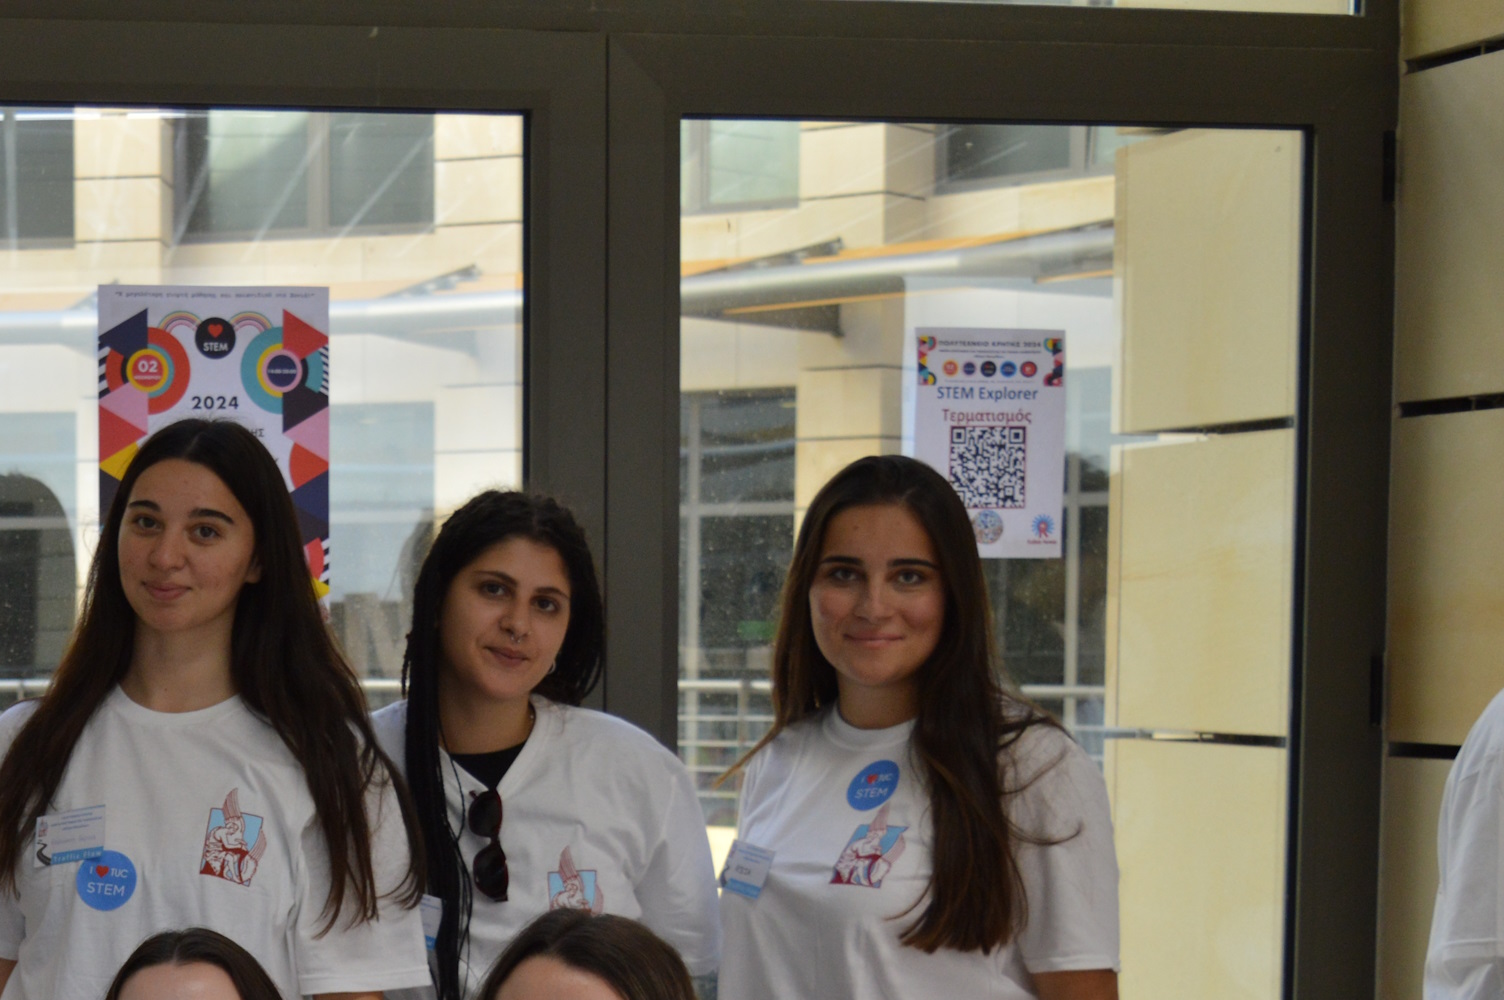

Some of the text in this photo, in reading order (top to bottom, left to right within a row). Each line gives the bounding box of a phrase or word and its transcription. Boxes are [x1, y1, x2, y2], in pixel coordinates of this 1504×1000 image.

[203, 342, 228, 352] STEM
[137, 360, 158, 373] 02
[937, 386, 1038, 403] STEM Explorer
[192, 396, 239, 410] 2024
[942, 408, 1032, 424] Τερματισμός
[855, 788, 888, 799] STEM
[111, 868, 128, 878] TUC
[86, 882, 125, 896] STEM
